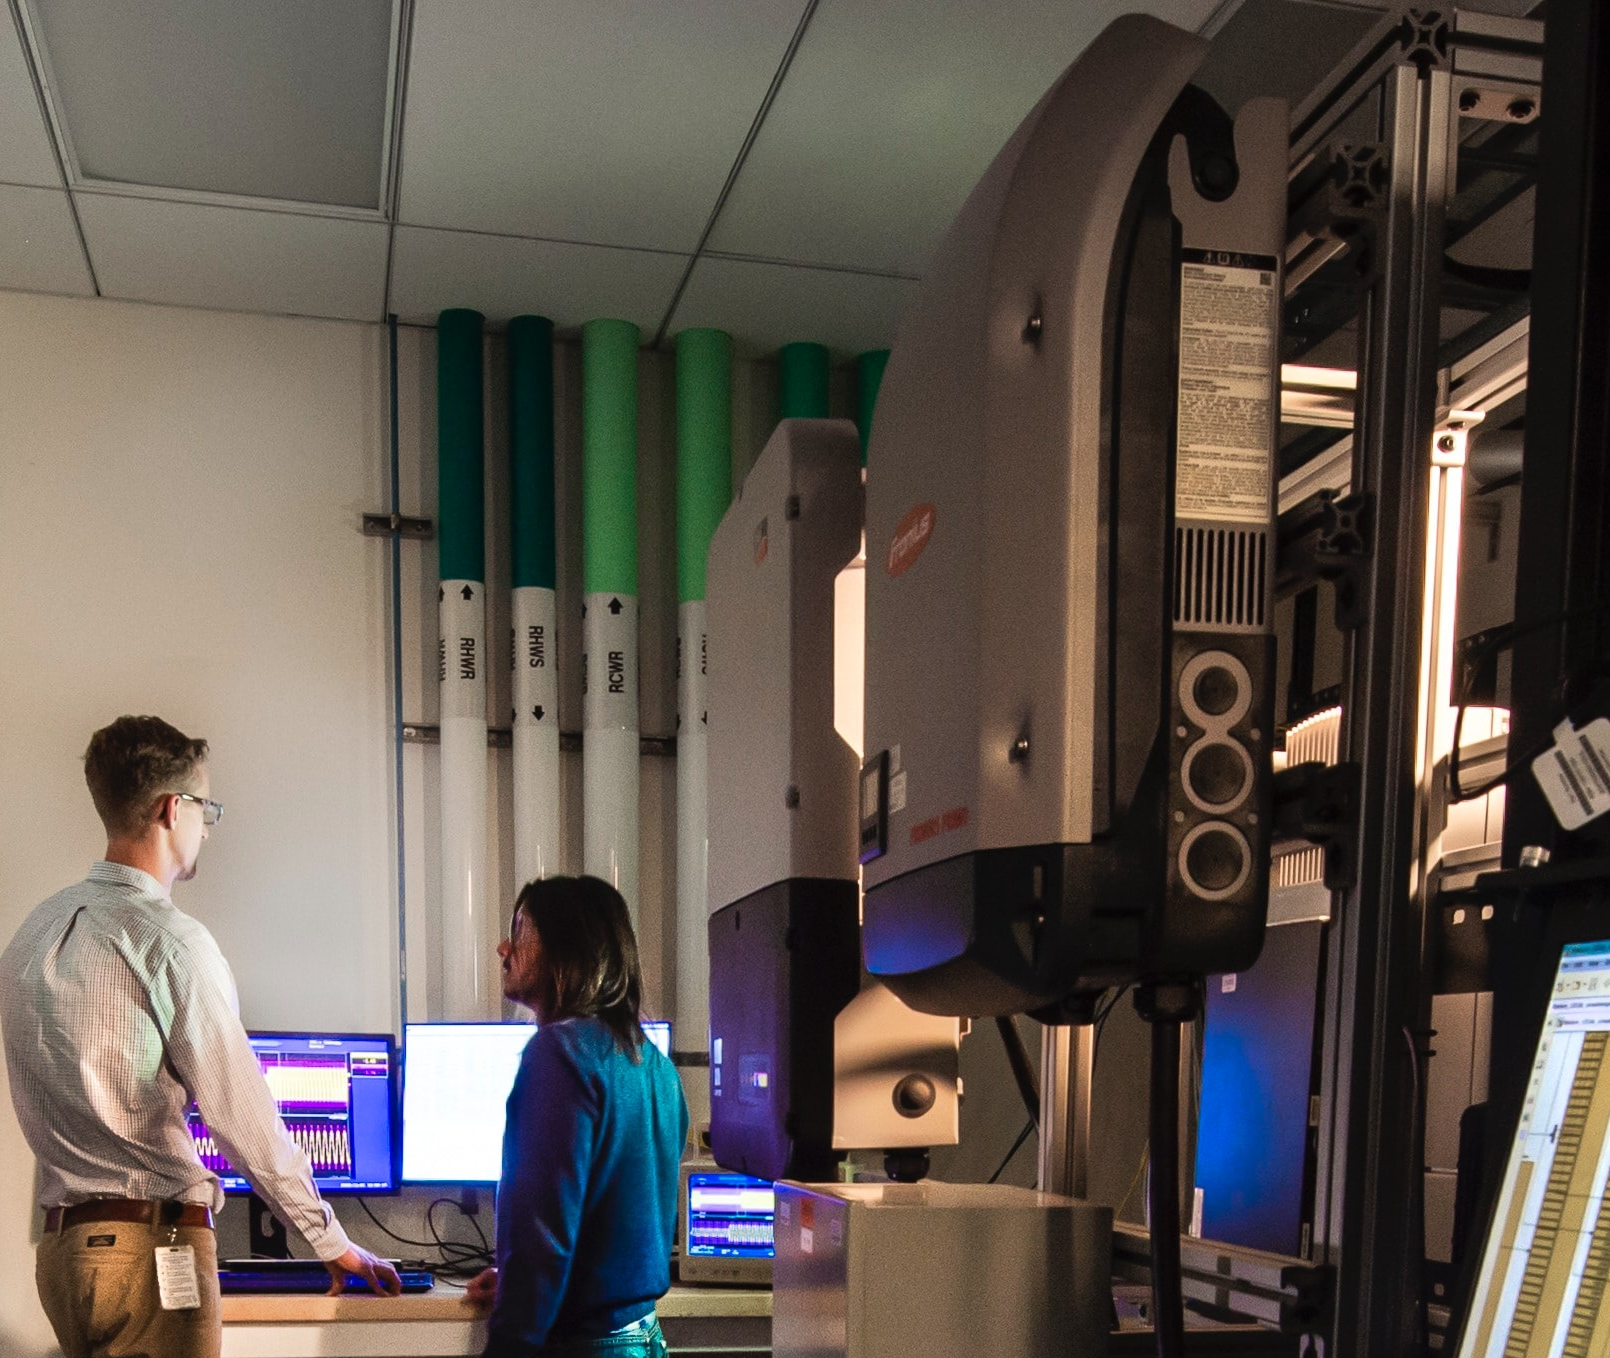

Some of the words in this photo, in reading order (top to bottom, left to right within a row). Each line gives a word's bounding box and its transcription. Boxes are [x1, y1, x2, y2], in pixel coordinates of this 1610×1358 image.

[460, 637, 475, 680] RHWR
[528, 625, 544, 668] RHWS
[608, 651, 624, 693] RCWR
